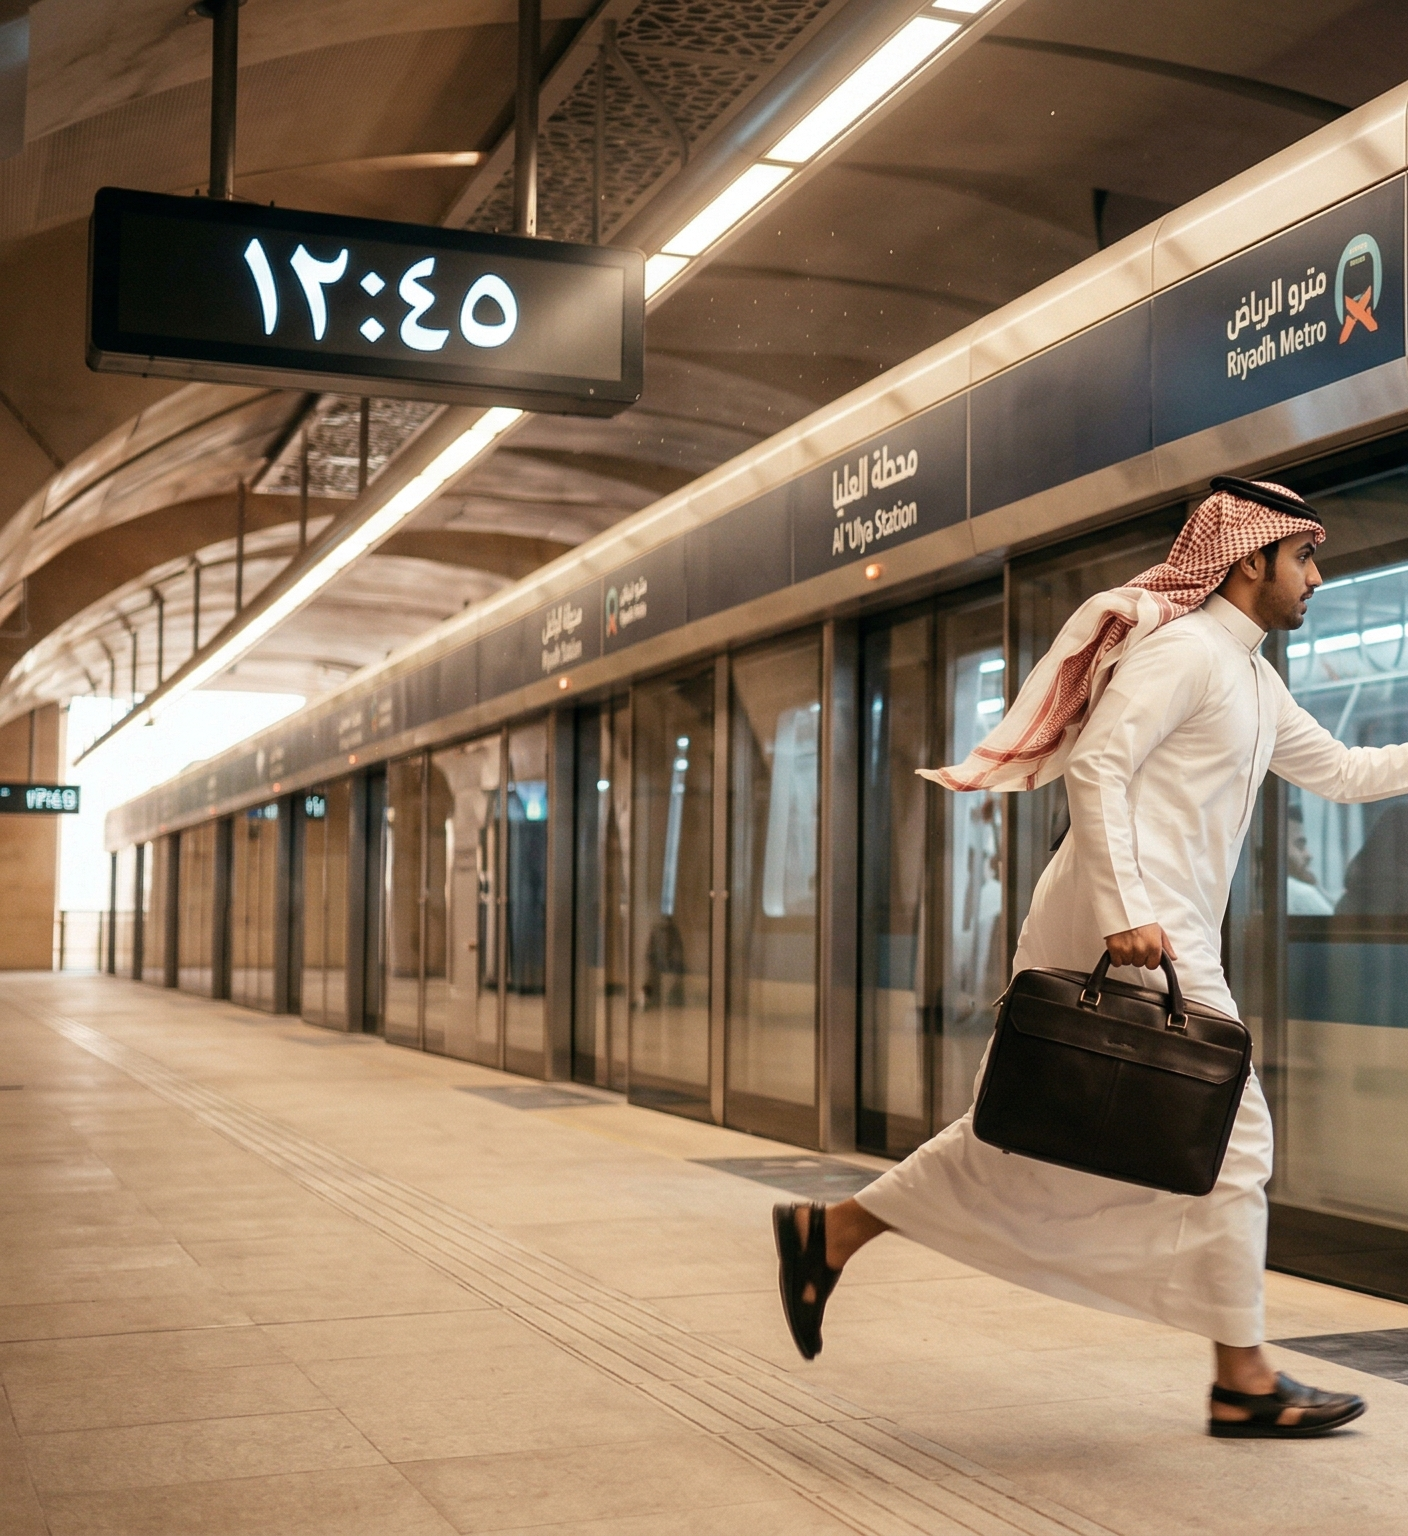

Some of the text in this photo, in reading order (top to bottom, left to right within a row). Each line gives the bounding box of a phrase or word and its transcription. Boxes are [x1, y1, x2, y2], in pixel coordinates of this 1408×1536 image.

[243, 237, 518, 351] ١٢:٤٥
[1227, 267, 1327, 340] مترو الرياض
[1227, 321, 1327, 380] Riyadh Metro
[833, 445, 918, 518] محطة العليا
[832, 522, 844, 556] Al
[875, 499, 918, 540] Station
